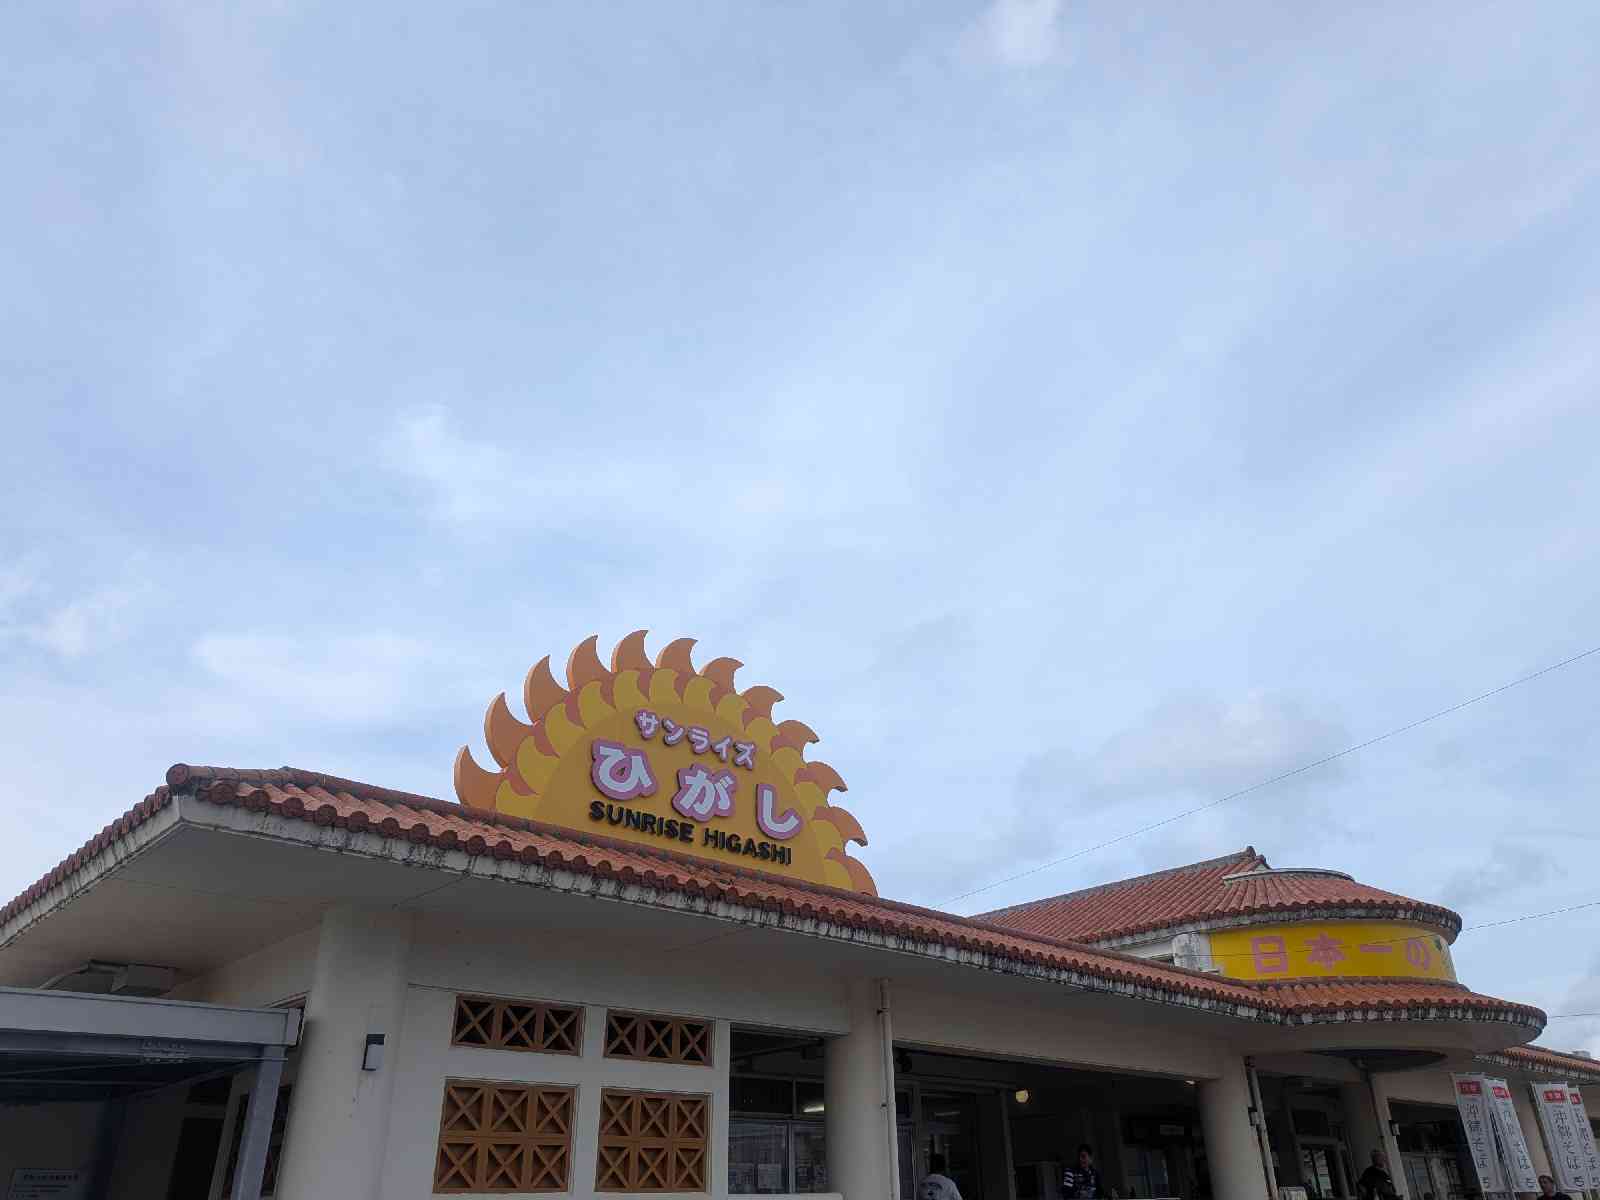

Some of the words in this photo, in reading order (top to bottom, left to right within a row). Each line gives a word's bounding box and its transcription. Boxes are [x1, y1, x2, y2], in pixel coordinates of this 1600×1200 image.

[636, 709, 755, 769] サンライズ
[593, 741, 803, 838] ひがし
[590, 800, 695, 842] SUNRISE
[704, 828, 792, 865] HIGASHI
[1251, 932, 1431, 974] 日本一の
